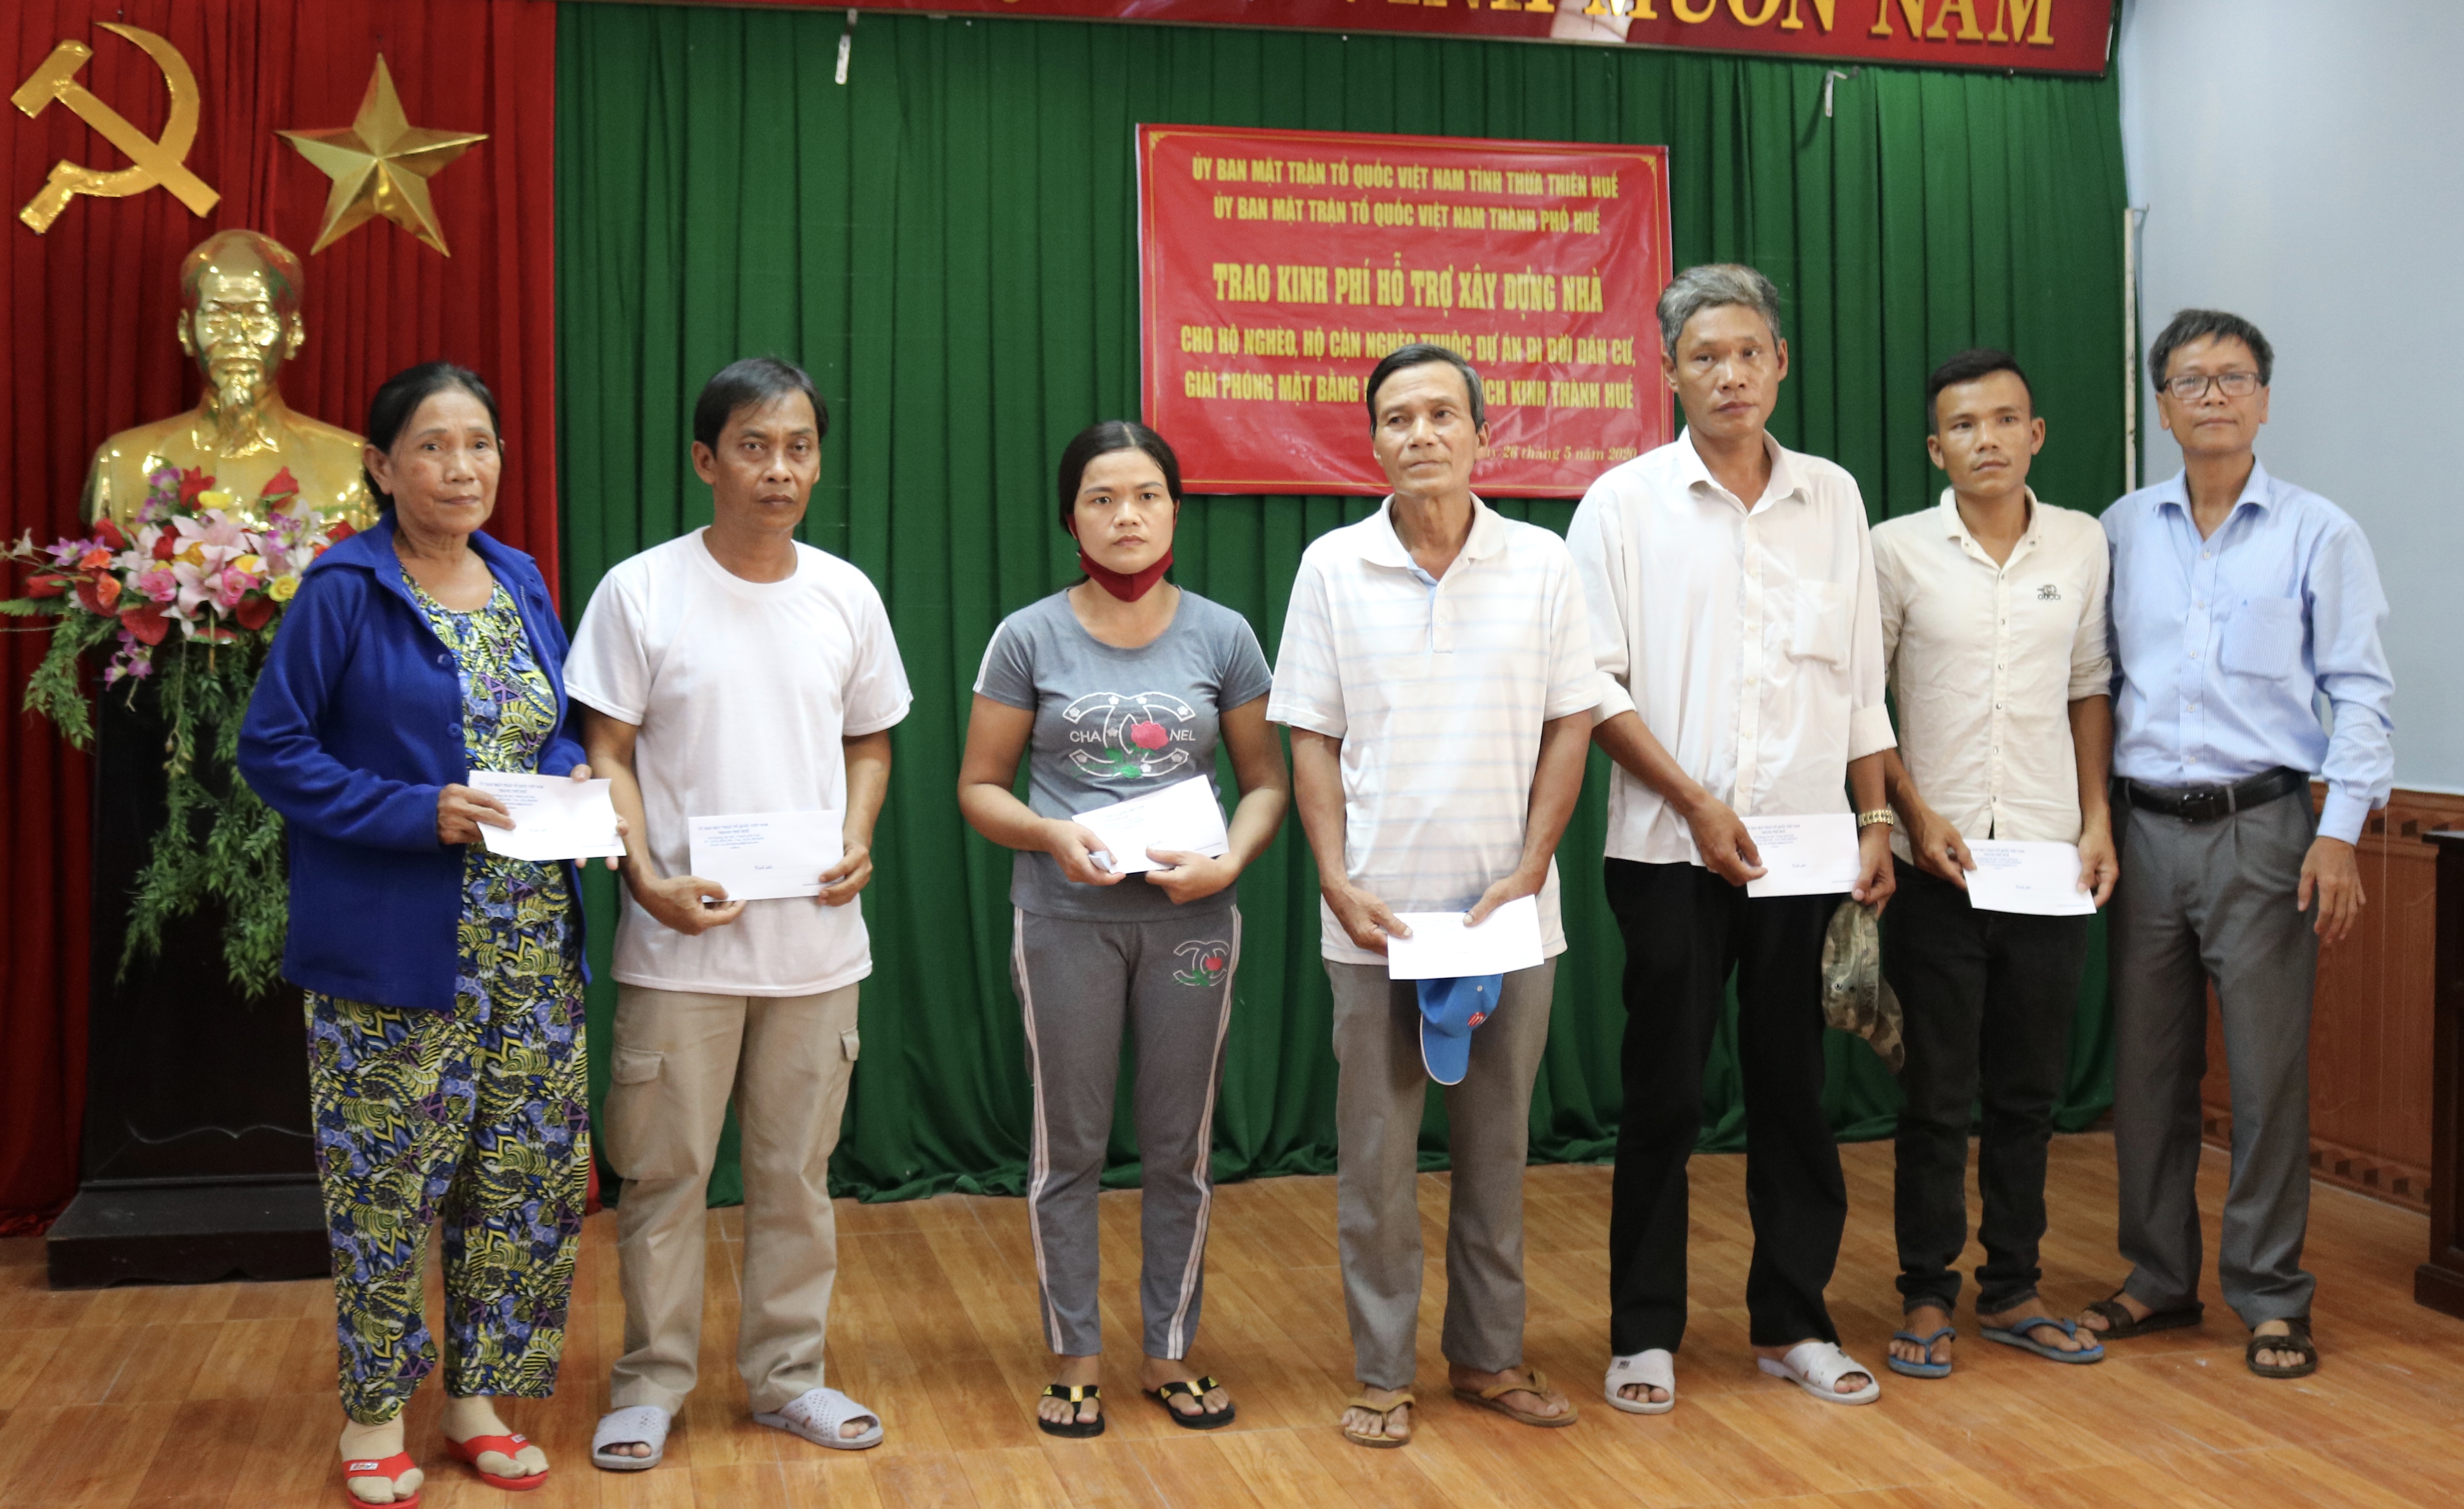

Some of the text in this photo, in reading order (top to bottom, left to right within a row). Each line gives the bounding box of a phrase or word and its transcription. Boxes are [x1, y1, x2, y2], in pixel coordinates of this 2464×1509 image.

[1216, 158, 1247, 182] BAN
[1287, 158, 1326, 188] TRẬN
[1353, 158, 1394, 189] QUỐC
[1397, 163, 1429, 193] VIỆT
[1433, 167, 1465, 191] NAM
[1547, 171, 1587, 197] THIÊN
[1591, 170, 1619, 199] HUẾ
[1237, 196, 1268, 220] BAN
[1308, 197, 1347, 227] TRẬN
[1373, 196, 1415, 227] QUỐC
[1418, 201, 1449, 232] VIỆT
[1453, 206, 1485, 229] NAM
[1489, 205, 1536, 232] THÀNH
[1540, 204, 1569, 233] PHỐ
[1573, 205, 1600, 234] HUẾ
[1213, 251, 1603, 321] TRAO KINH PHÍ HỖ TRỢ XÂY DỰNG NHÀ
[1181, 325, 1213, 353] CHO
[1217, 323, 1239, 358] HỘ
[1244, 325, 1299, 358] NGHÈO,
[1303, 326, 1325, 362] HỘ
[1329, 326, 1361, 363] CẬN
[1476, 332, 1498, 366] DỰ
[1501, 332, 1522, 363] ÁN
[1547, 332, 1573, 364] DỜI
[1577, 334, 1608, 365] DÂN
[1612, 336, 1636, 367] CƯ,
[1278, 370, 1313, 406] MẶT
[1316, 367, 1360, 402] BẰNG
[1510, 379, 1547, 407] KINH
[1550, 377, 1600, 408] THÀNH
[1604, 374, 1634, 409] HUẾ
[1502, 445, 1518, 459] 26
[1521, 445, 1561, 462] tháng
[1564, 445, 1572, 460] 5
[1576, 446, 1604, 461] năm
[1607, 446, 1638, 462] 2020
[1069, 729, 1196, 744] CHA NEL
